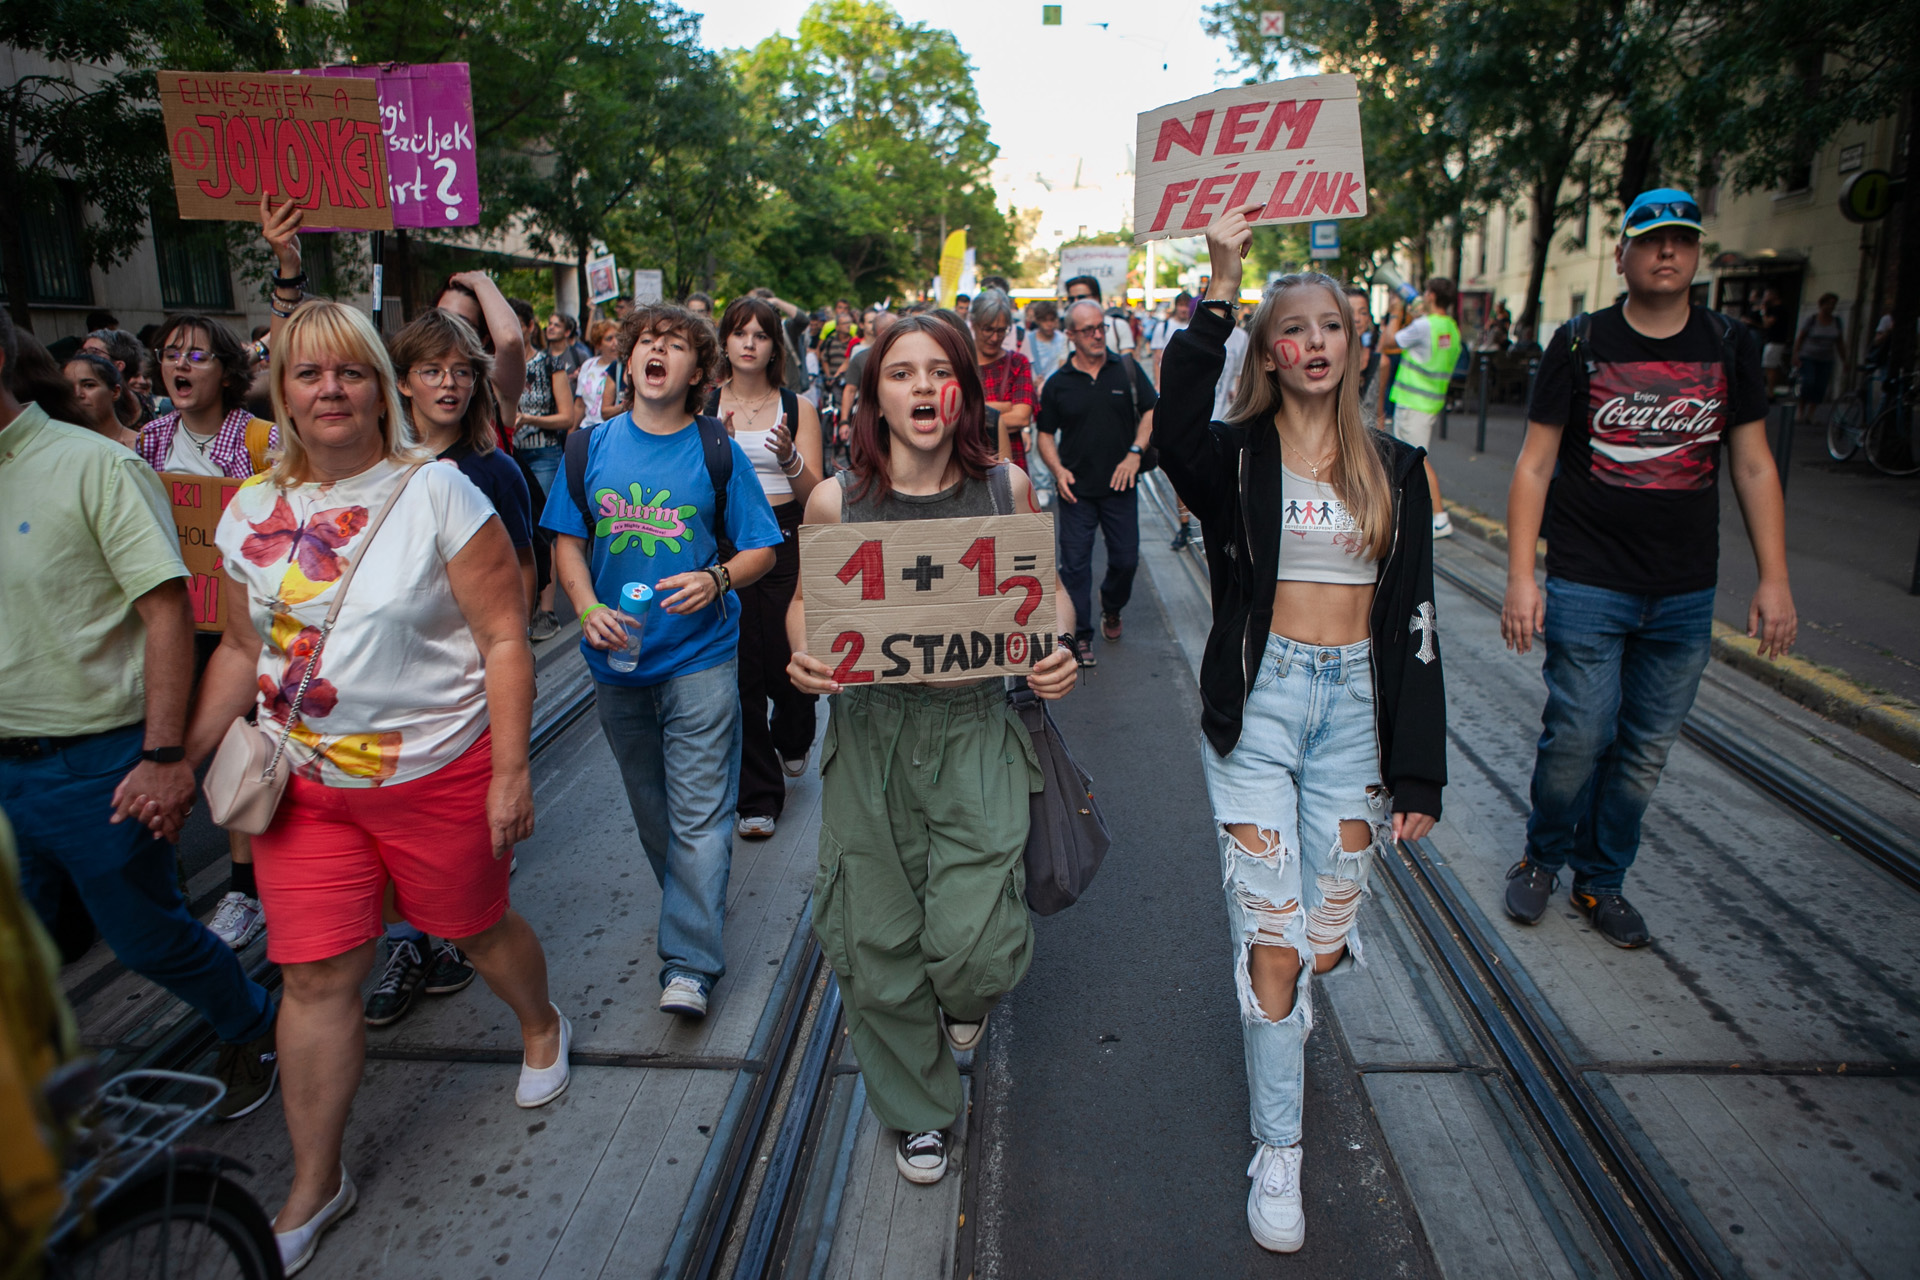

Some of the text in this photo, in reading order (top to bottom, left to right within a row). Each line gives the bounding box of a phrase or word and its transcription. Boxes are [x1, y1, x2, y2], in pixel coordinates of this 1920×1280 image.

[334, 88, 349, 112] A
[1152, 98, 1324, 162] NEM
[1148, 159, 1362, 233] FÉLÜNK
[1633, 391, 1660, 403] Enjoy
[1592, 397, 1722, 434] Coca-Cola
[599, 492, 681, 522] Slurm
[178, 525, 217, 547] HOL
[835, 539, 886, 601] 1
[958, 536, 997, 597] 1
[831, 630, 1053, 684] 2 STADION
[259, 1051, 278, 1063] FIL
